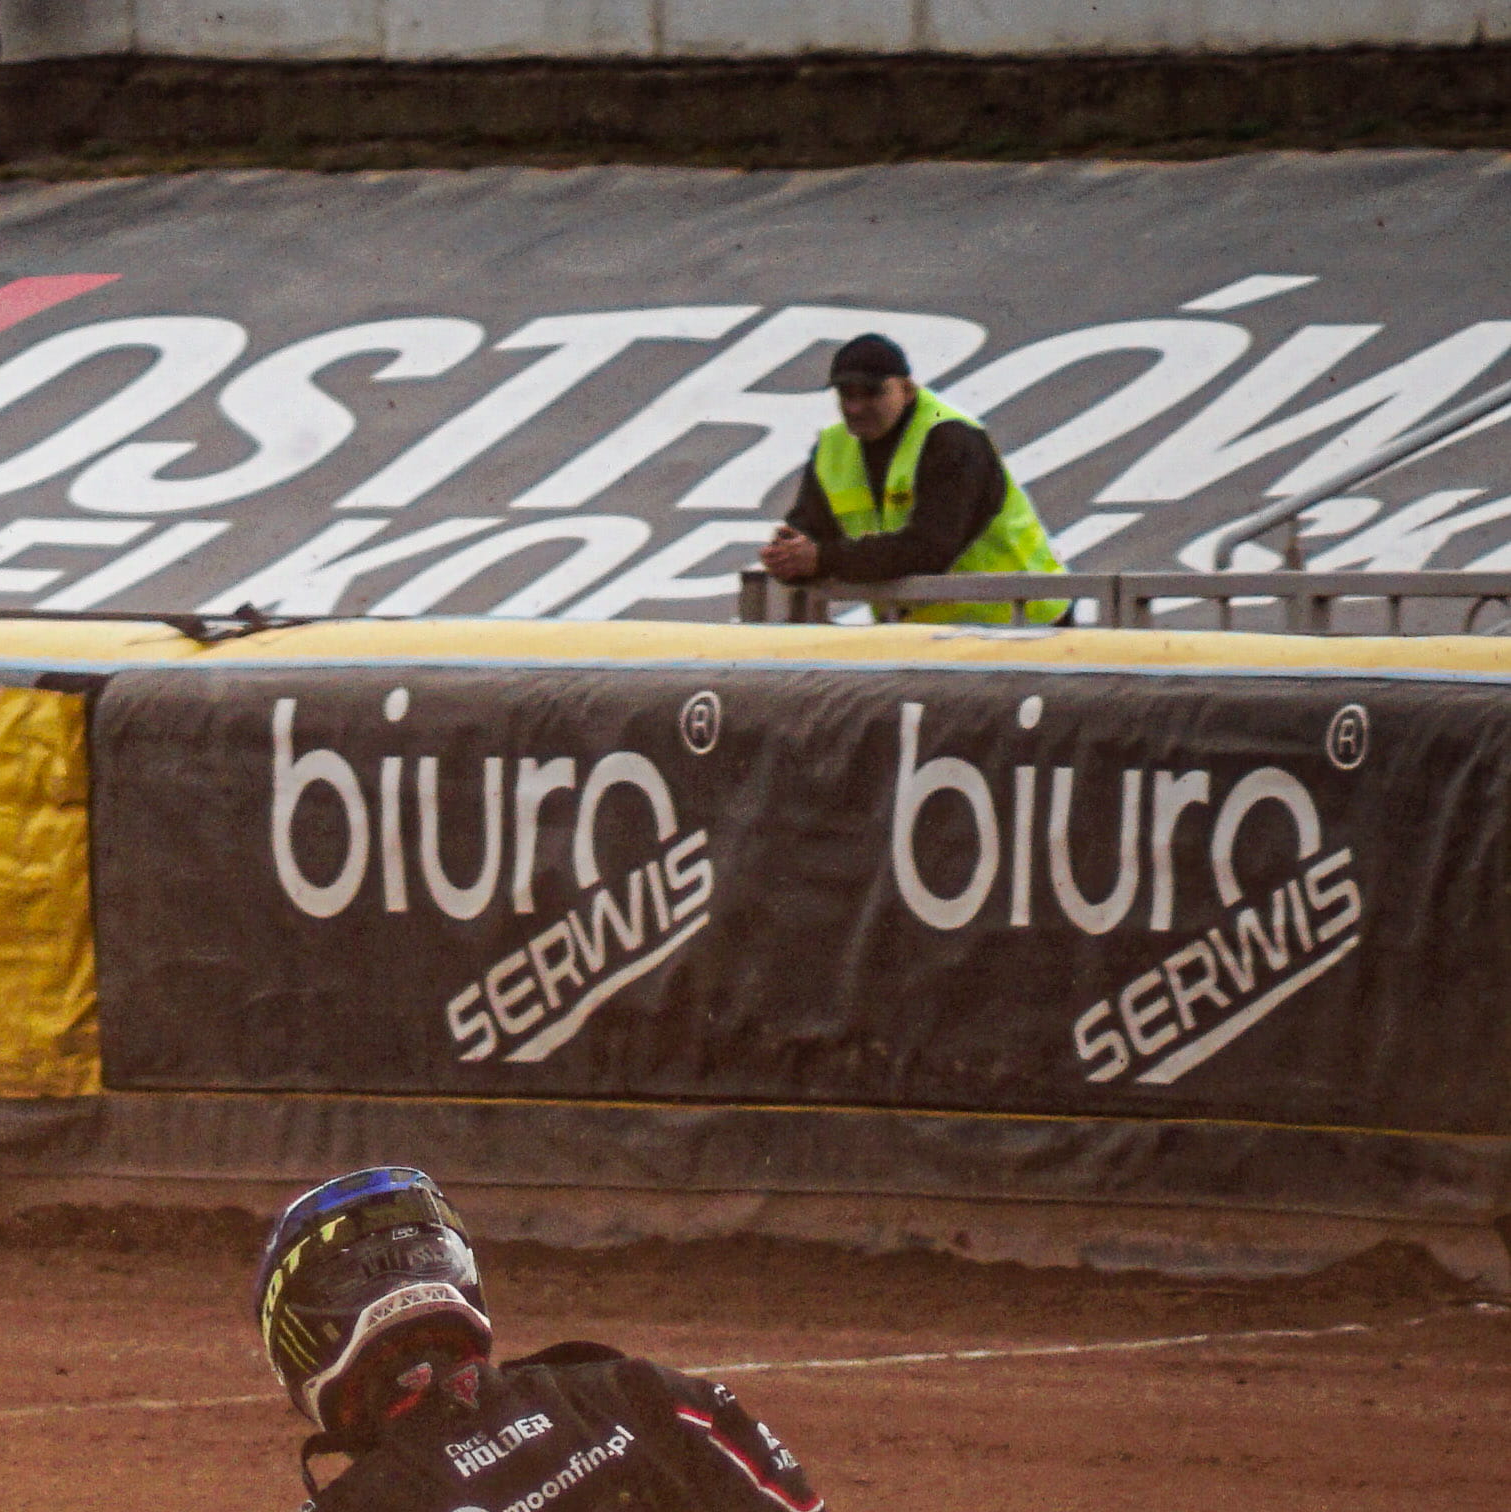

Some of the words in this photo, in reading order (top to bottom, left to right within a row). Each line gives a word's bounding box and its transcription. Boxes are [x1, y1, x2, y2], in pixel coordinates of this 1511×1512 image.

[272, 687, 677, 919] biuro
[892, 695, 1321, 934] biuro
[447, 830, 714, 1062] SERWIS
[1074, 848, 1362, 1083] SERWIS
[453, 1412, 553, 1477] HOLDER
